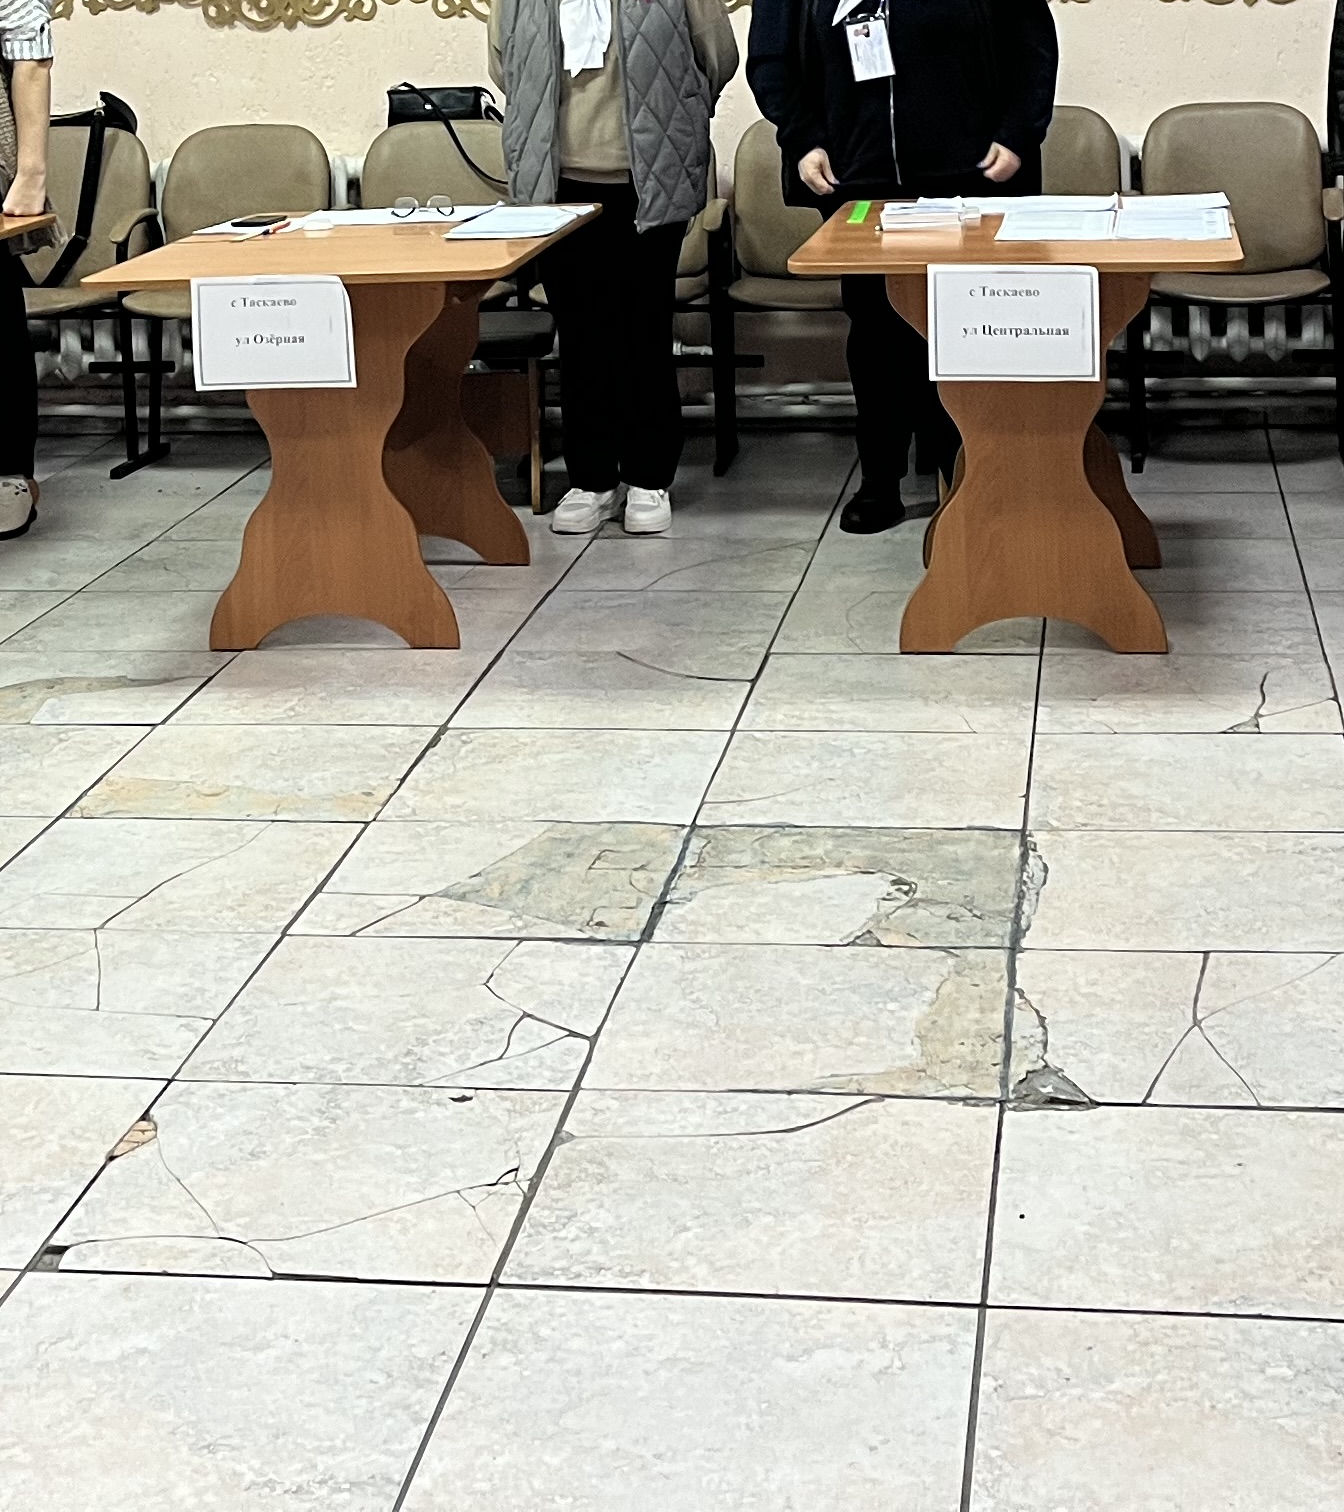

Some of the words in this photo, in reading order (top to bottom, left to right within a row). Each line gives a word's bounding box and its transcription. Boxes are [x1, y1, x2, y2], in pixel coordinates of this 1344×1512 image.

[979, 285, 1040, 297] Таскаево
[240, 296, 297, 308] Таскаево
[962, 327, 978, 338] ул
[982, 324, 1070, 338] Центральная
[235, 337, 250, 347] ул
